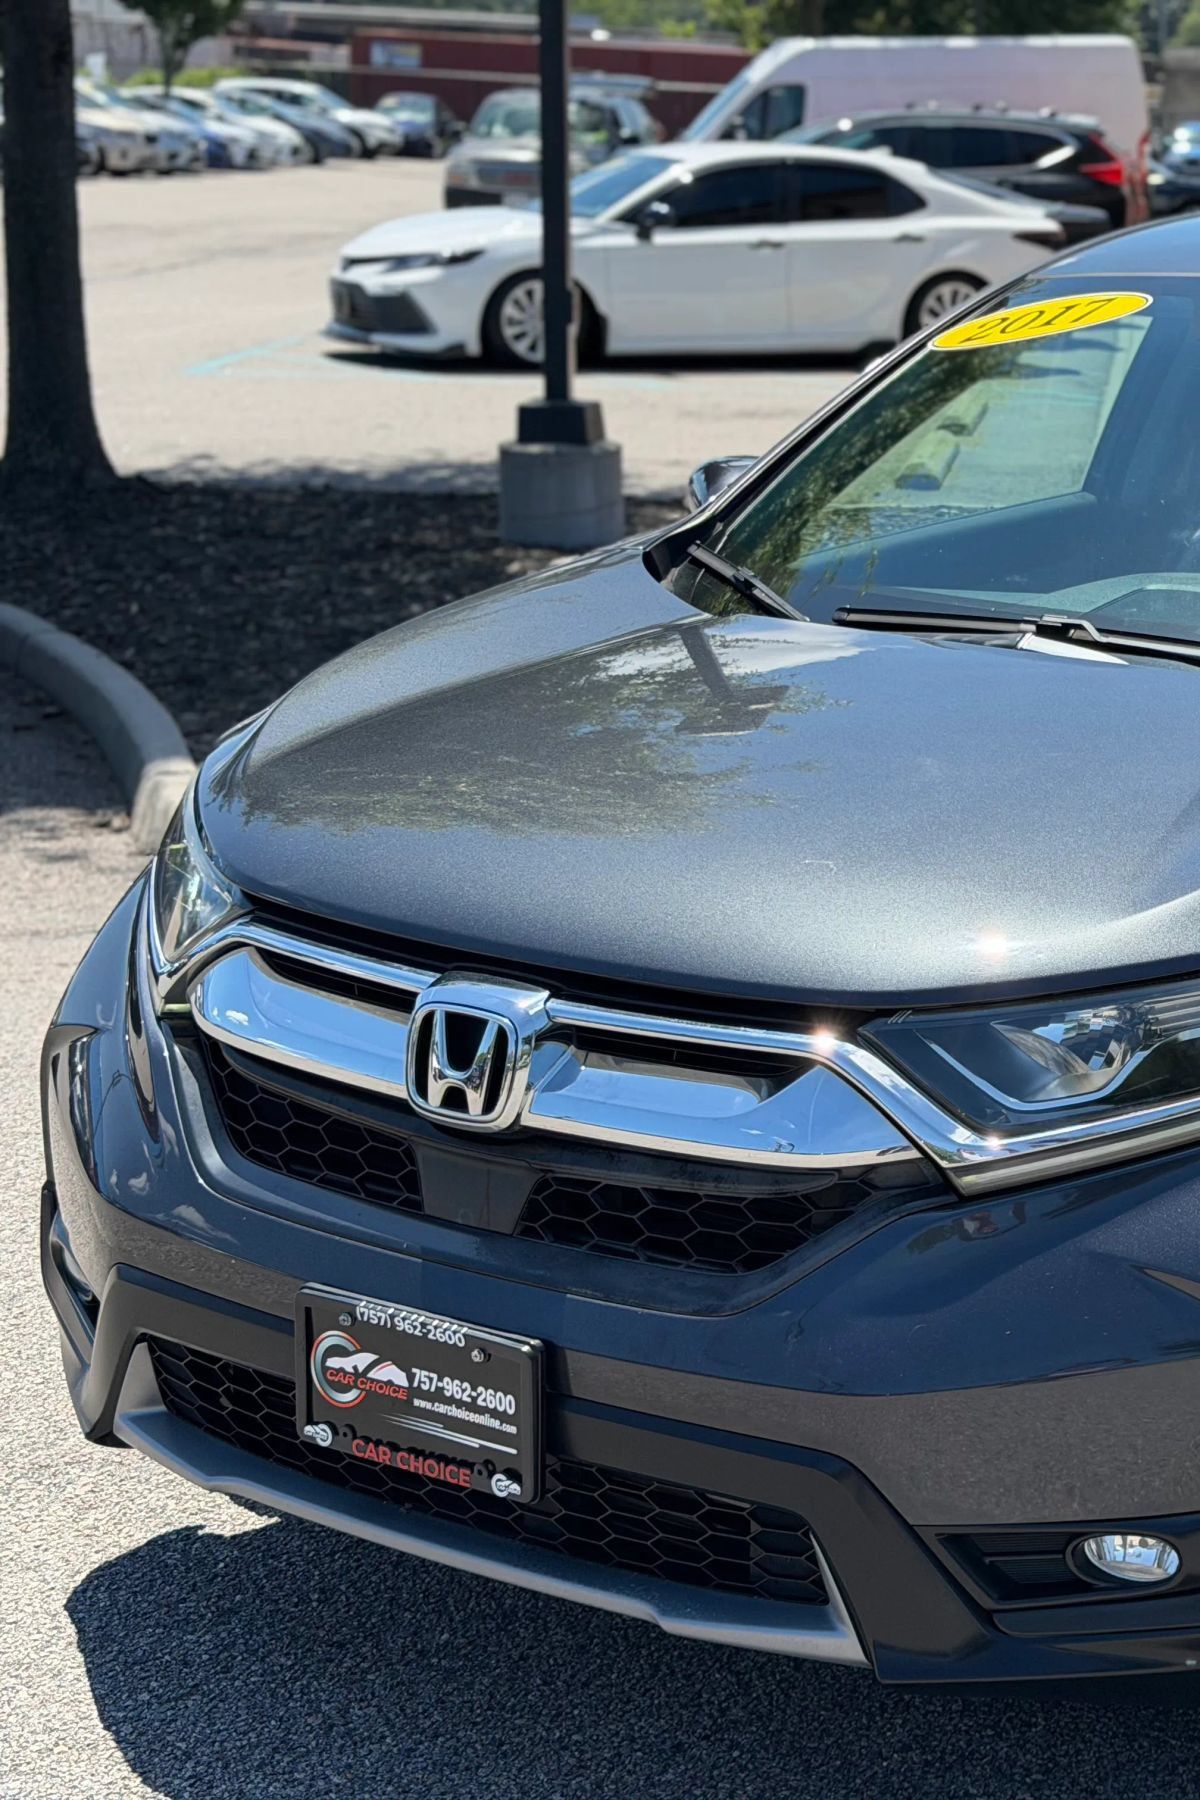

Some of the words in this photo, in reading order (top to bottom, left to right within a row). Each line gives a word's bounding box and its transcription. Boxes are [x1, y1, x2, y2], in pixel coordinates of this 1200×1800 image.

[960, 297, 1119, 344] 2017
[355, 1305, 392, 1329] (757)
[393, 1316, 466, 1348] 962-2600
[326, 1369, 356, 1386] CAR
[357, 1378, 409, 1400] CHOICE
[411, 1367, 516, 1416] 757-962-2600
[412, 1398, 517, 1435] www.carchoiceonline.com
[352, 1439, 391, 1465] CAR
[396, 1451, 472, 1488] CHOICE
